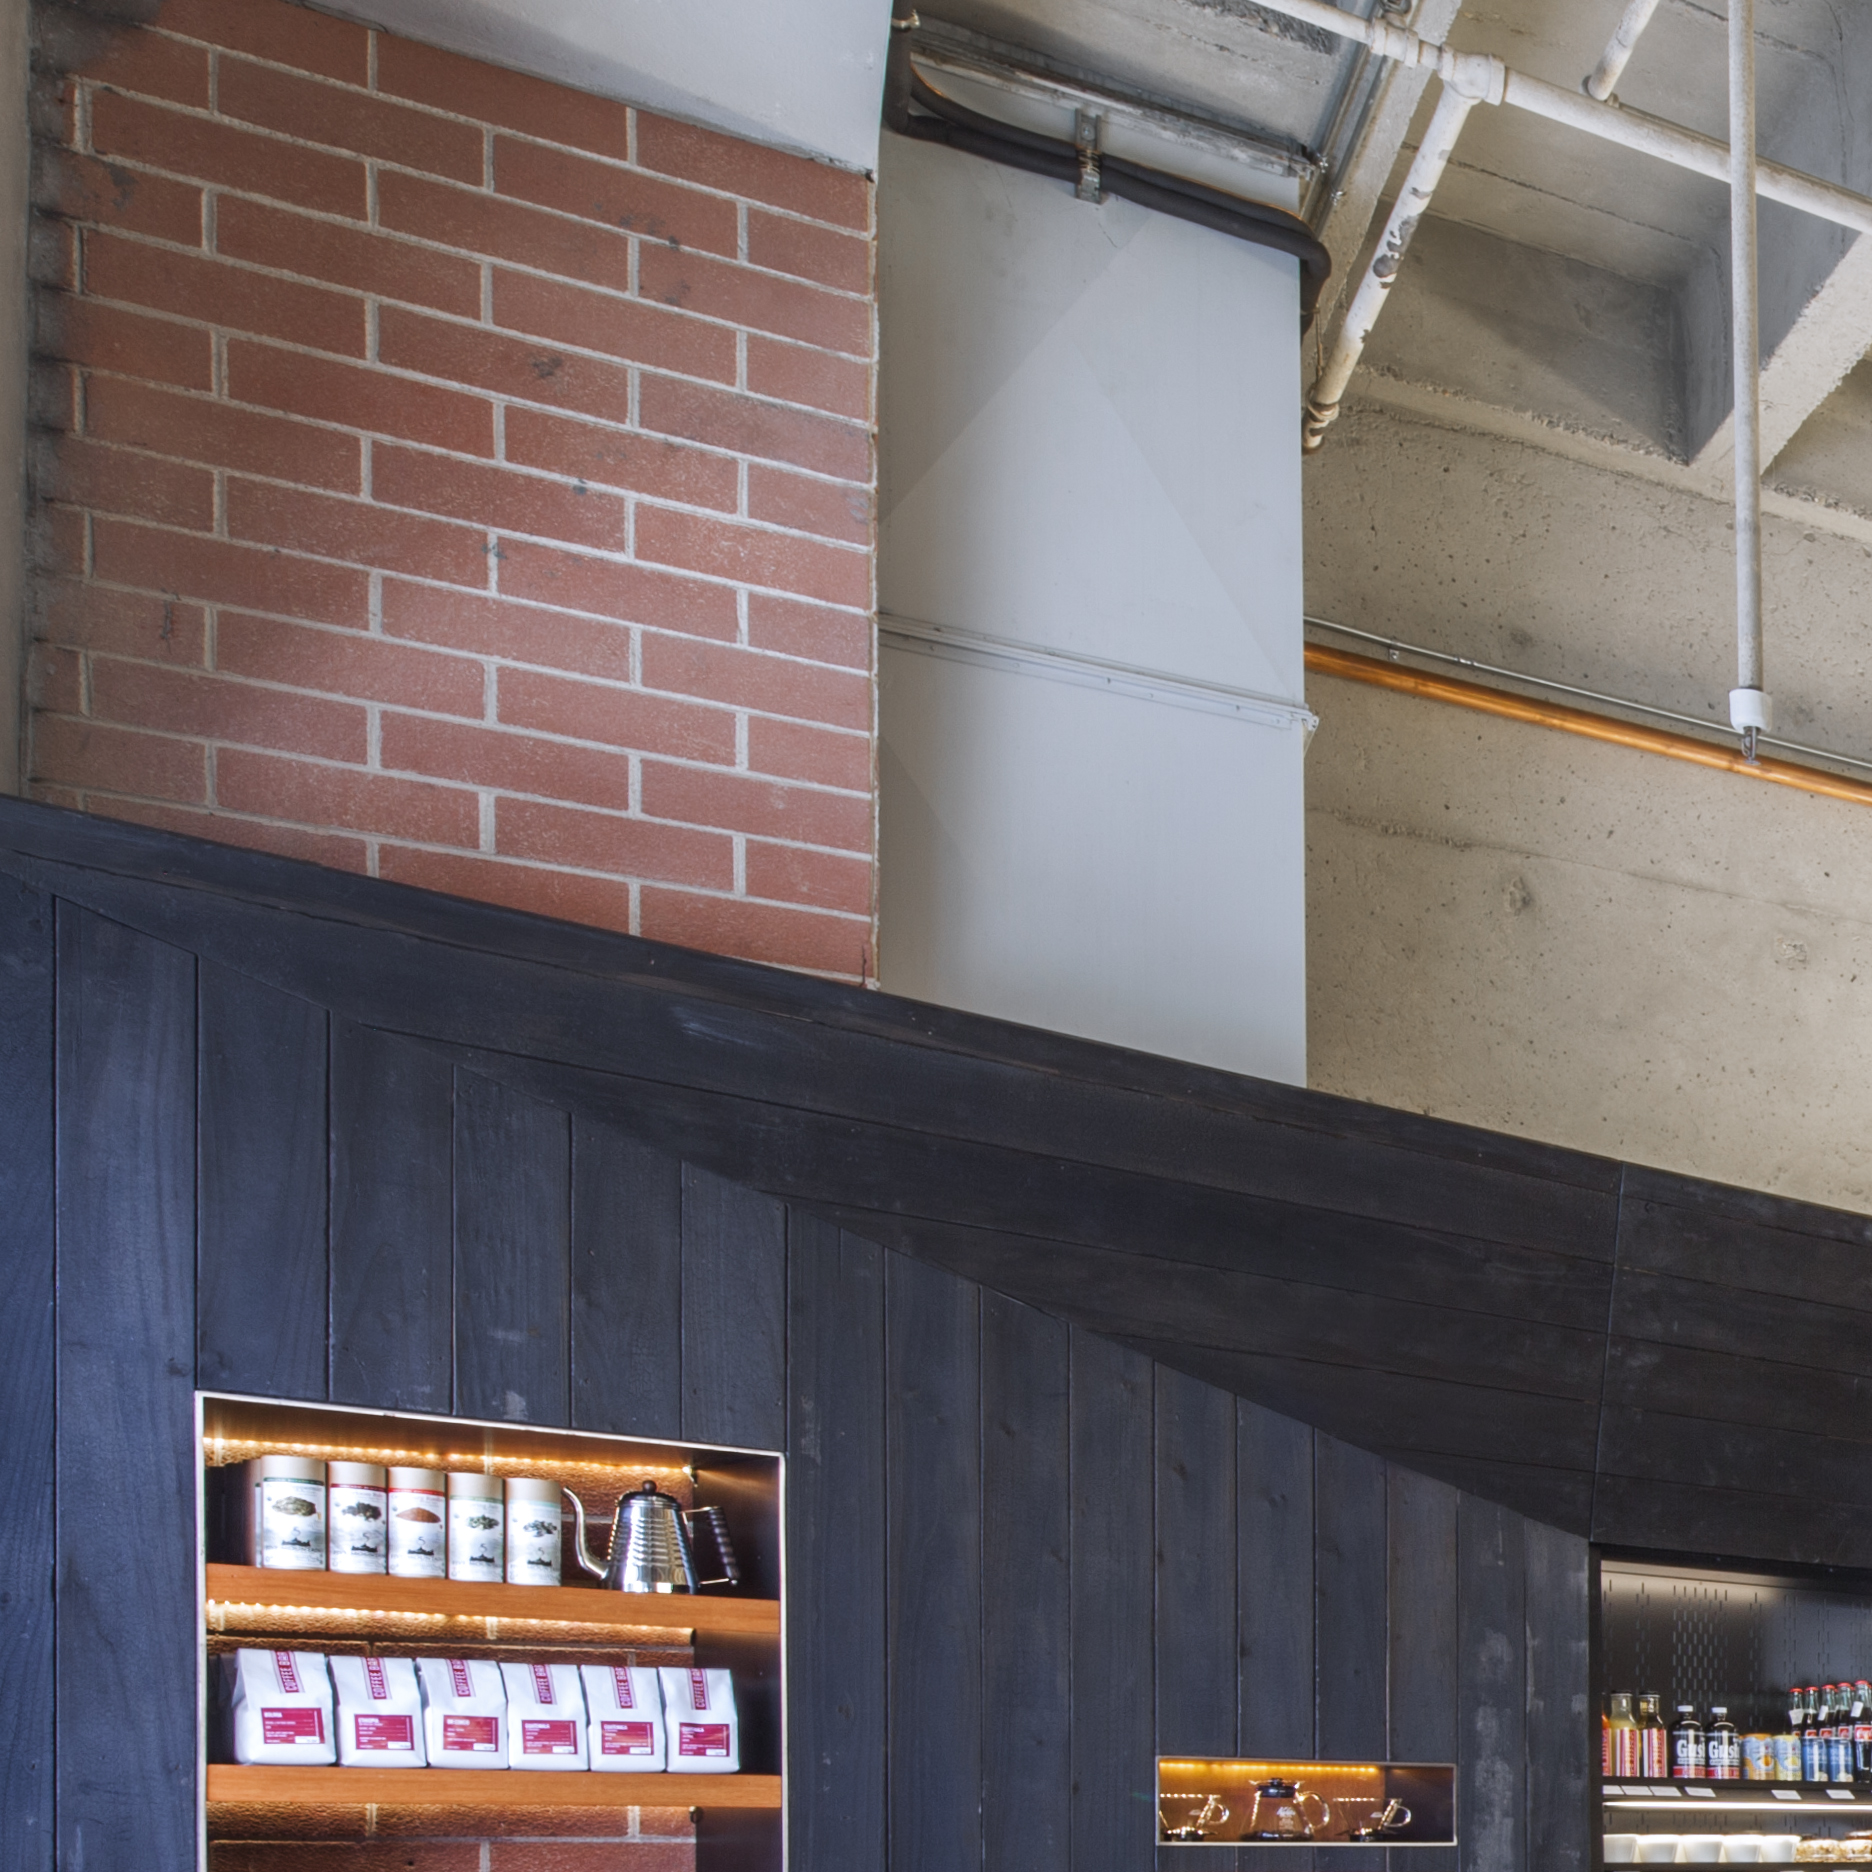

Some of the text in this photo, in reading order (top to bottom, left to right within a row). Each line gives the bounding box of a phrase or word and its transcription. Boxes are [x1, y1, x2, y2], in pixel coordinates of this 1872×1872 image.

[280, 1667, 299, 1691] COFFEE
[369, 1671, 386, 1698] COFFEE
[454, 1671, 470, 1696] COFFEE
[536, 1677, 551, 1703] COFFEE
[617, 1681, 632, 1707] COFFEE
[693, 1682, 706, 1708] COFFEE
